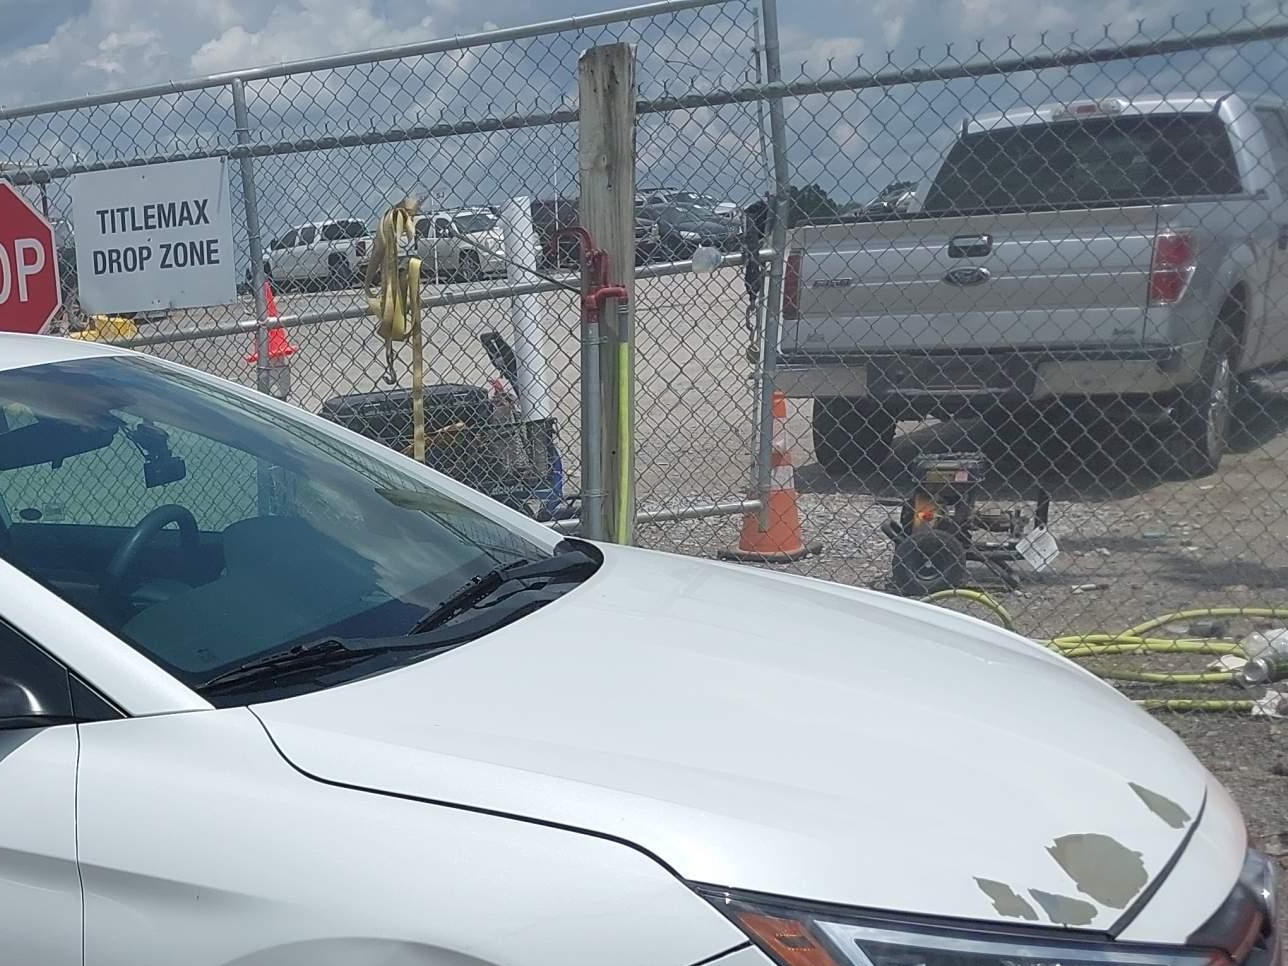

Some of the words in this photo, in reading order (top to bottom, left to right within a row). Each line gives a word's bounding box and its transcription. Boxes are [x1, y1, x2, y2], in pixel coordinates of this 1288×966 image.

[96, 199, 210, 234] TITLEMAX
[93, 246, 152, 275] DROP
[159, 239, 220, 269] ZONE
